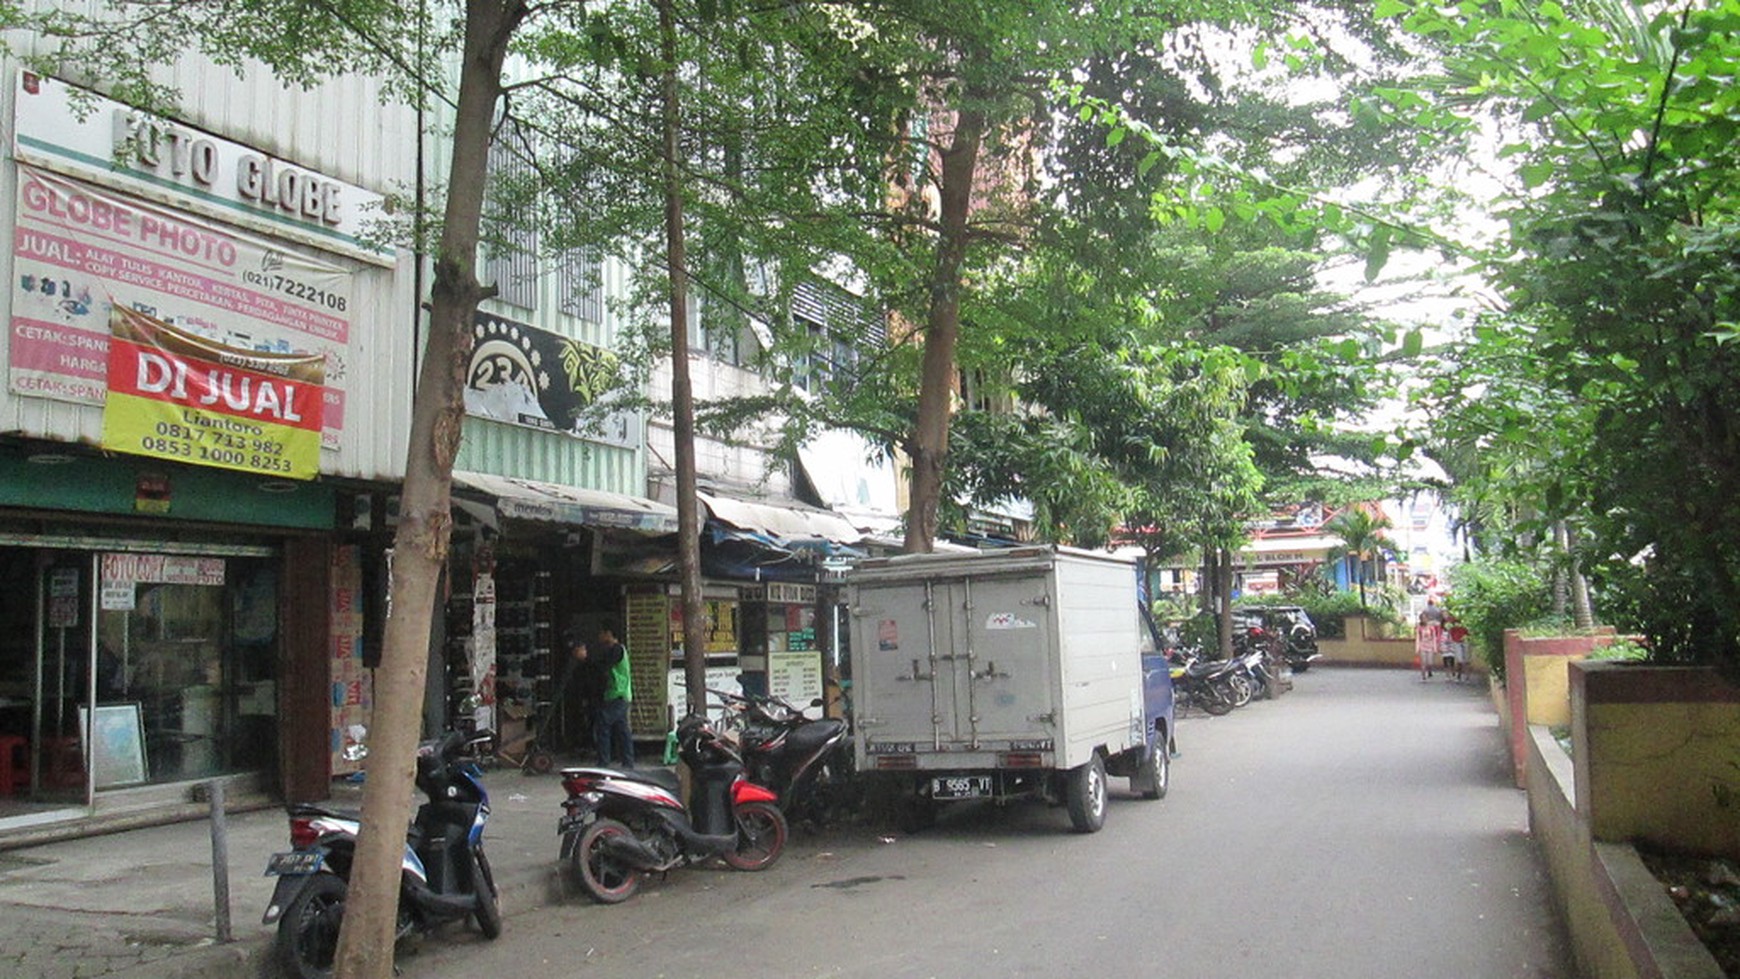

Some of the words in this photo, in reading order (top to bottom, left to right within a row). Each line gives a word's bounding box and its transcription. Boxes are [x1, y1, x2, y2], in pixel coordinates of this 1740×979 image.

[236, 154, 342, 225] GLOBE
[23, 180, 133, 238] GLOBE
[140, 214, 238, 267] PHOTO
[85, 260, 118, 278] COPY
[86, 248, 115, 265] ALAT
[60, 354, 107, 375] HARGA
[136, 351, 188, 399] DI
[200, 369, 302, 423] JUAL
[156, 421, 206, 441] 0817
[212, 430, 247, 450] 713
[252, 438, 284, 457] 982
[183, 410, 263, 437] Liantoro
[142, 436, 192, 457] 0853
[201, 446, 245, 465] 1000
[250, 454, 292, 473] 8253
[932, 778, 940, 793] B
